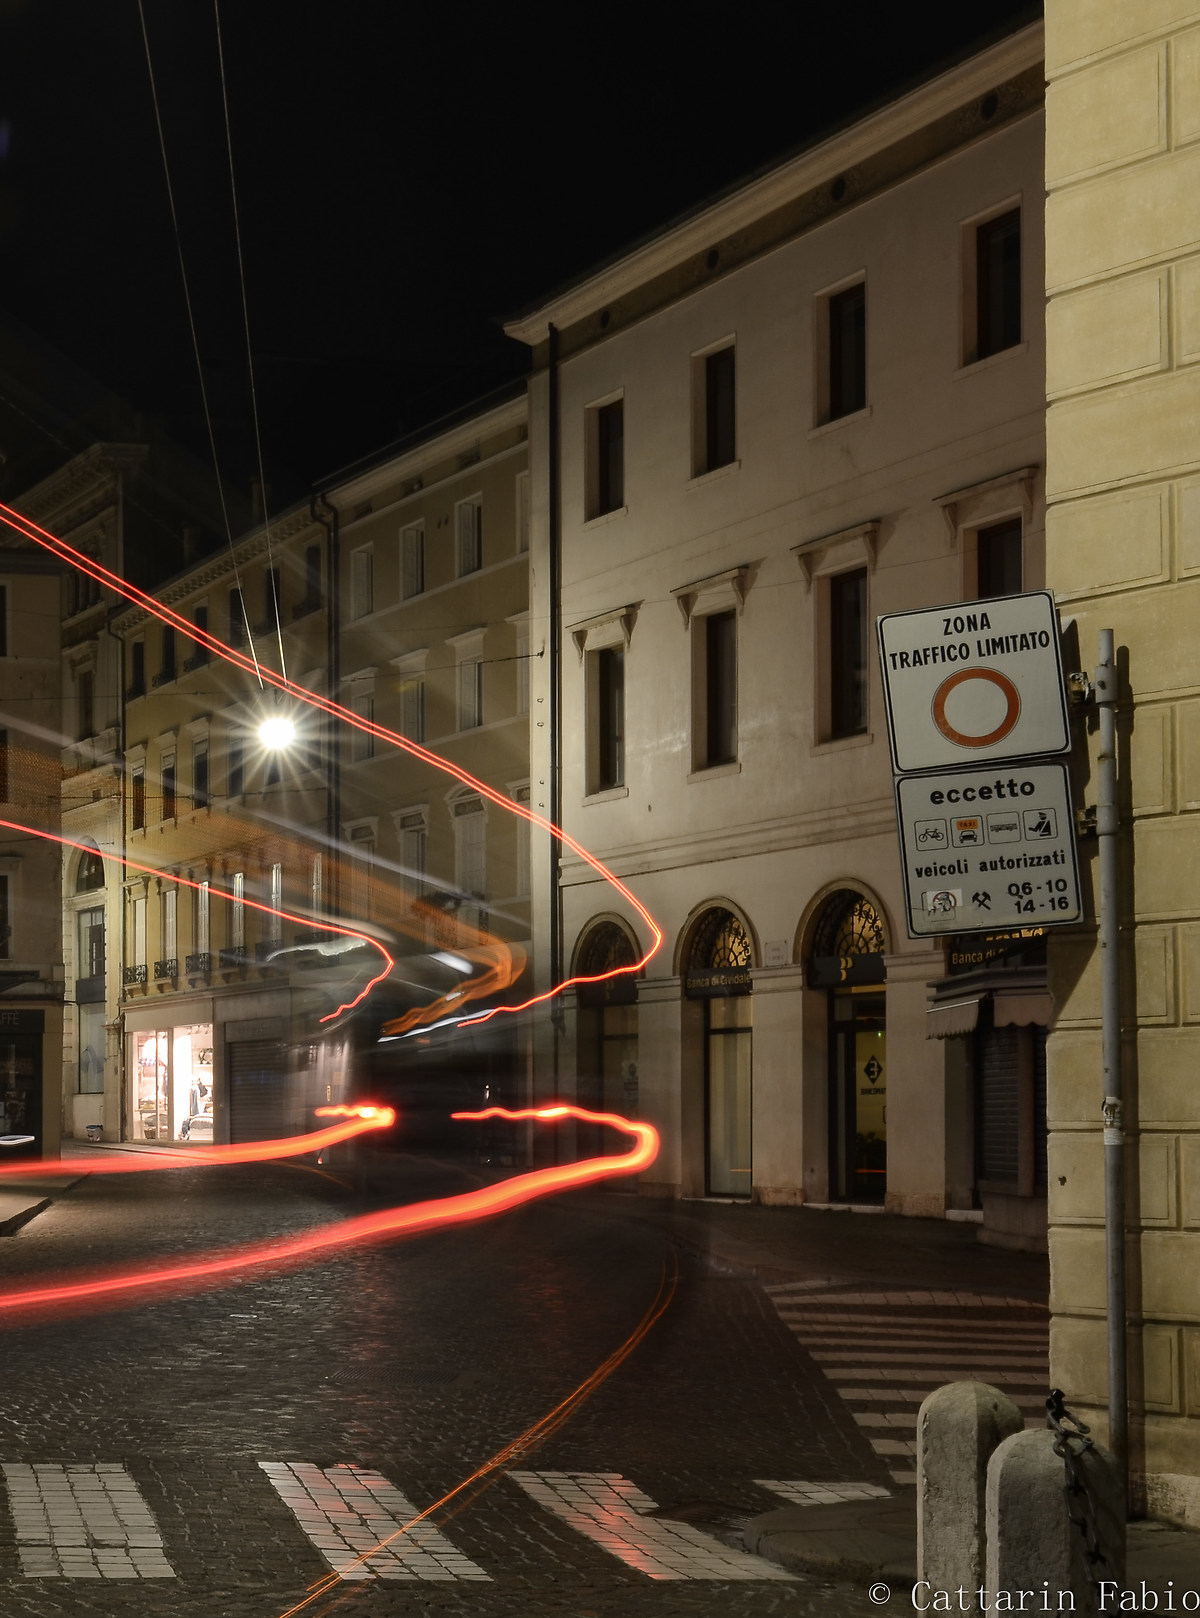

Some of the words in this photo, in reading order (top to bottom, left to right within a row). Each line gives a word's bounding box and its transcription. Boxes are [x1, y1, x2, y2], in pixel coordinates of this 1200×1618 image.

[943, 612, 991, 636] ZONA
[889, 643, 970, 670] TRAFFICO
[977, 630, 1050, 657] LIMITATO
[930, 778, 1035, 805] eccetto
[915, 859, 969, 879] veicoli
[979, 850, 1065, 873] autorizzati
[952, 952, 983, 965] Banca
[687, 977, 710, 988] Banca
[711, 975, 719, 986] di
[720, 973, 751, 985] Cividale
